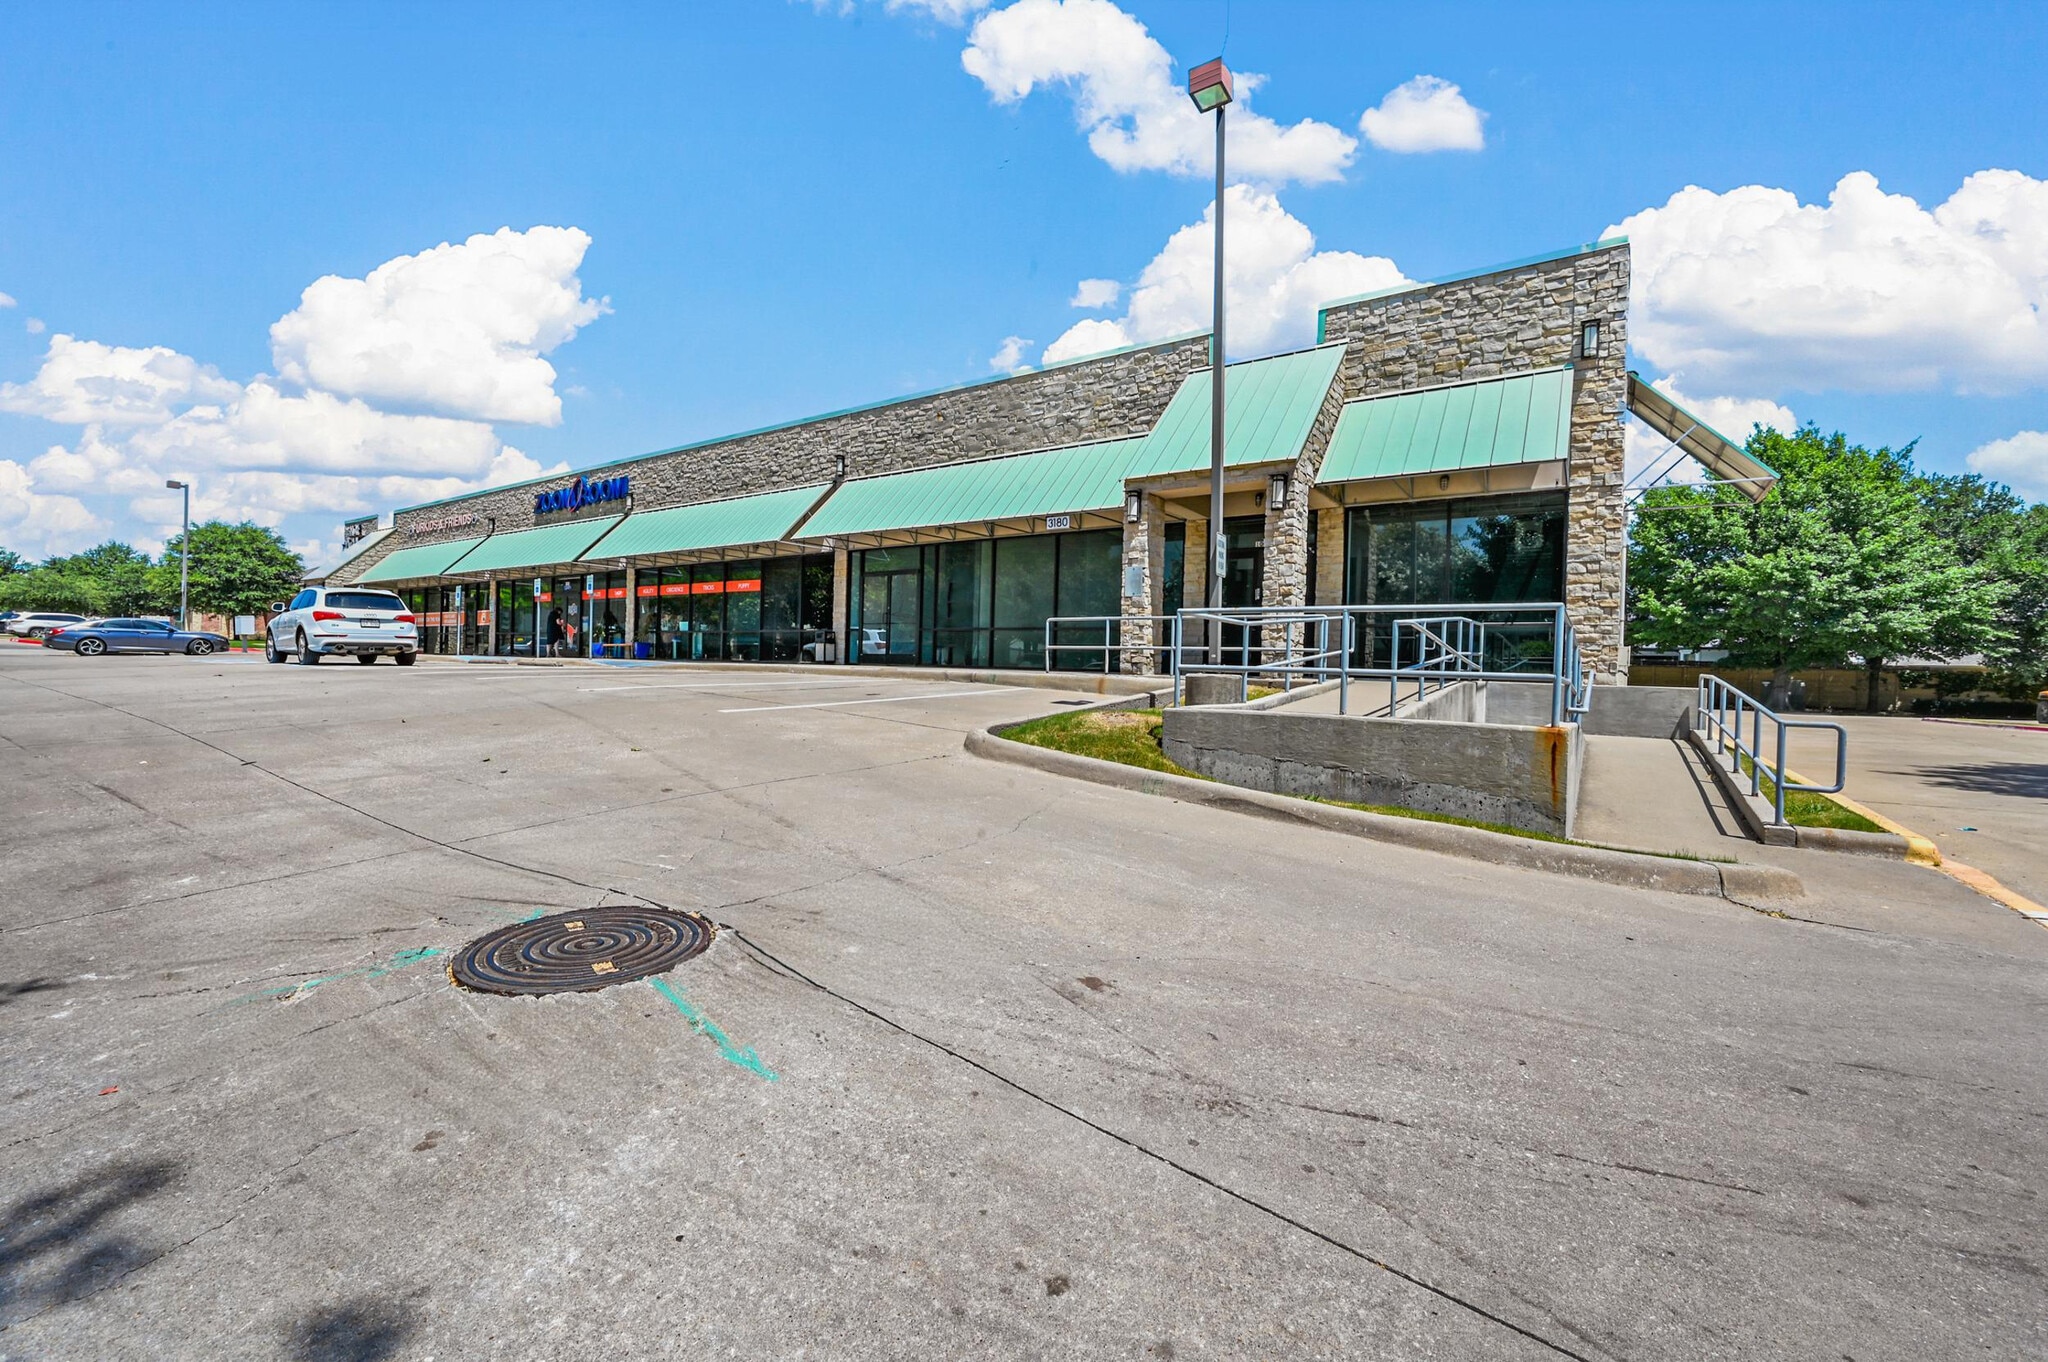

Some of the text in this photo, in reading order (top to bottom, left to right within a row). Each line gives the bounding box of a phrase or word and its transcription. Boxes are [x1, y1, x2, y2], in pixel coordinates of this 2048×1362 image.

[533, 475, 629, 514] ZOOM ROOM
[1047, 516, 1068, 529] 3180
